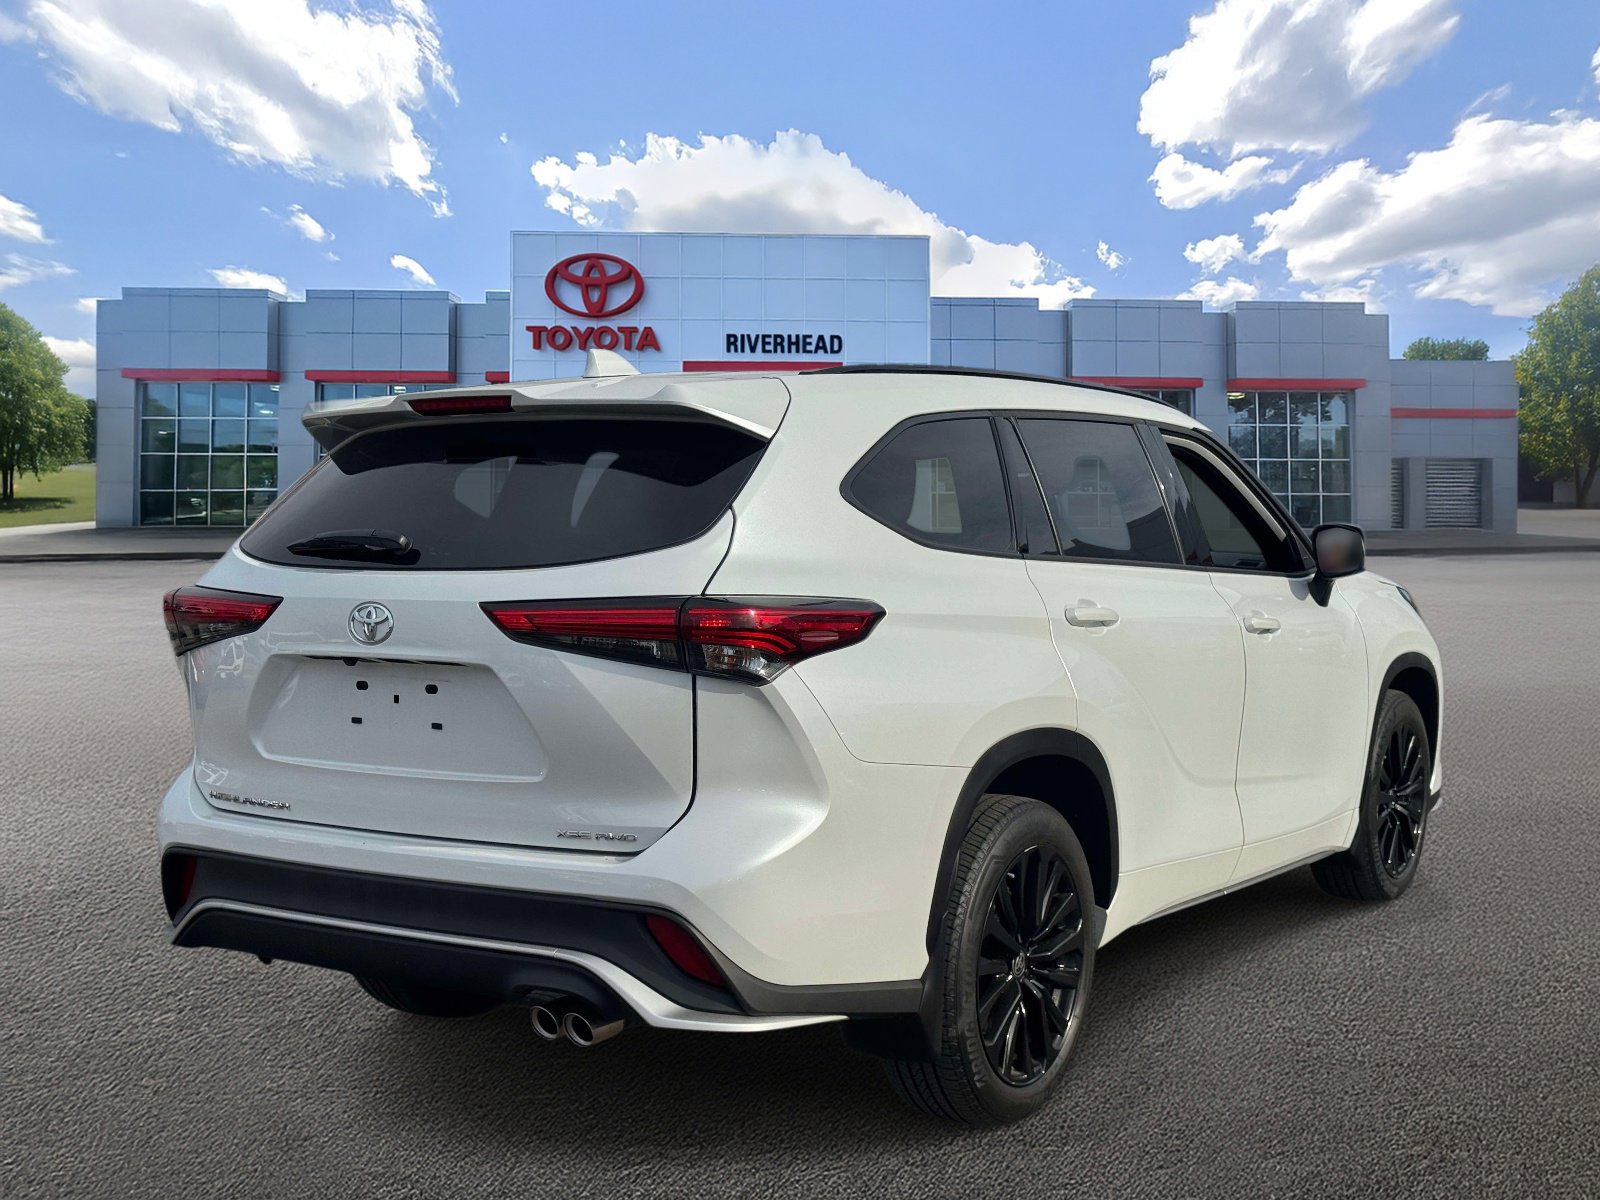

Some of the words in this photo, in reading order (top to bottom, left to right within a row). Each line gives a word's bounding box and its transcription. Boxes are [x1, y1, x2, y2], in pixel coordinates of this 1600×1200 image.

[526, 325, 661, 351] TOYOTA
[725, 334, 844, 354] RIVERHEAD
[556, 829, 592, 840] XSE
